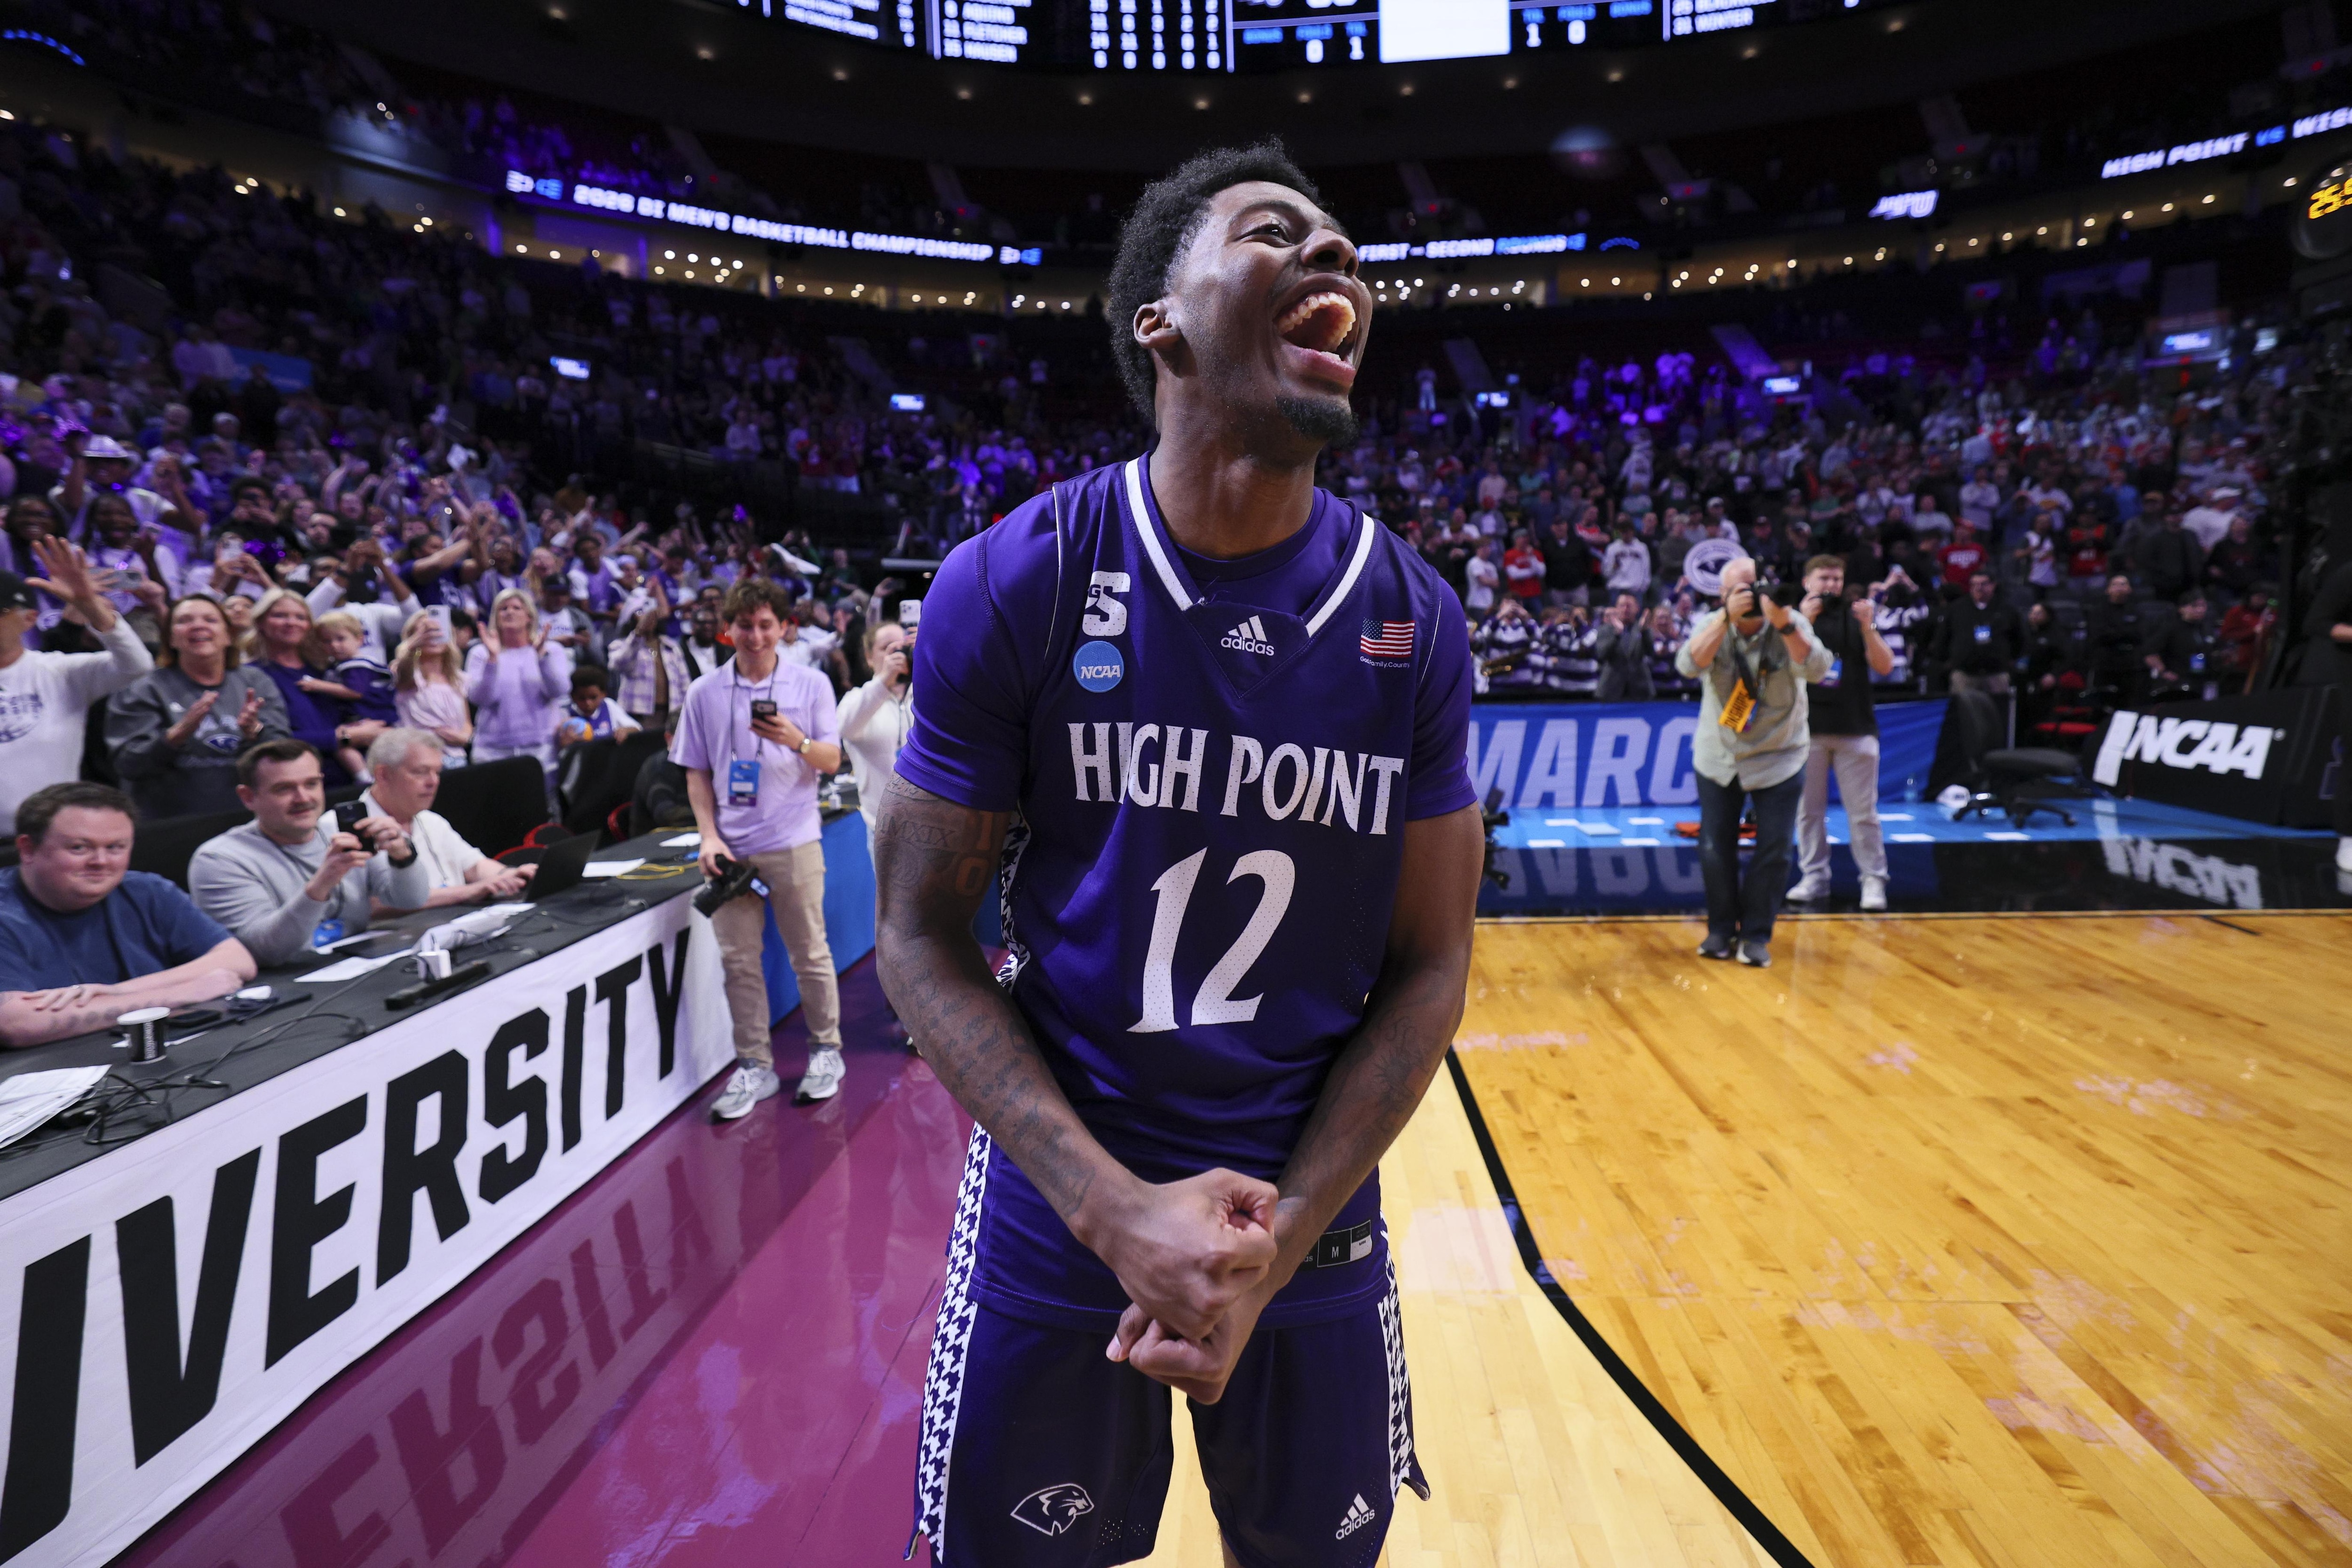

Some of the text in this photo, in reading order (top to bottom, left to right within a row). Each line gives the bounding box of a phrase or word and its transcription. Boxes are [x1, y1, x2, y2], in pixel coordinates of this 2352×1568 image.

[2101, 149, 2165, 179] HIGH
[2166, 132, 2250, 166] POINT
[2292, 105, 2352, 138] WISC
[731, 215, 850, 248] BASKETBALL
[851, 231, 993, 261] CHAMPIONSHIP
[1221, 636, 1274, 656] adidas
[1081, 665, 1120, 679] NCAA
[1067, 721, 1405, 835] HIGH POINT
[1126, 846, 1295, 1033] 12
[1331, 1246, 1339, 1258] M
[1335, 1509, 1375, 1540] adidas
